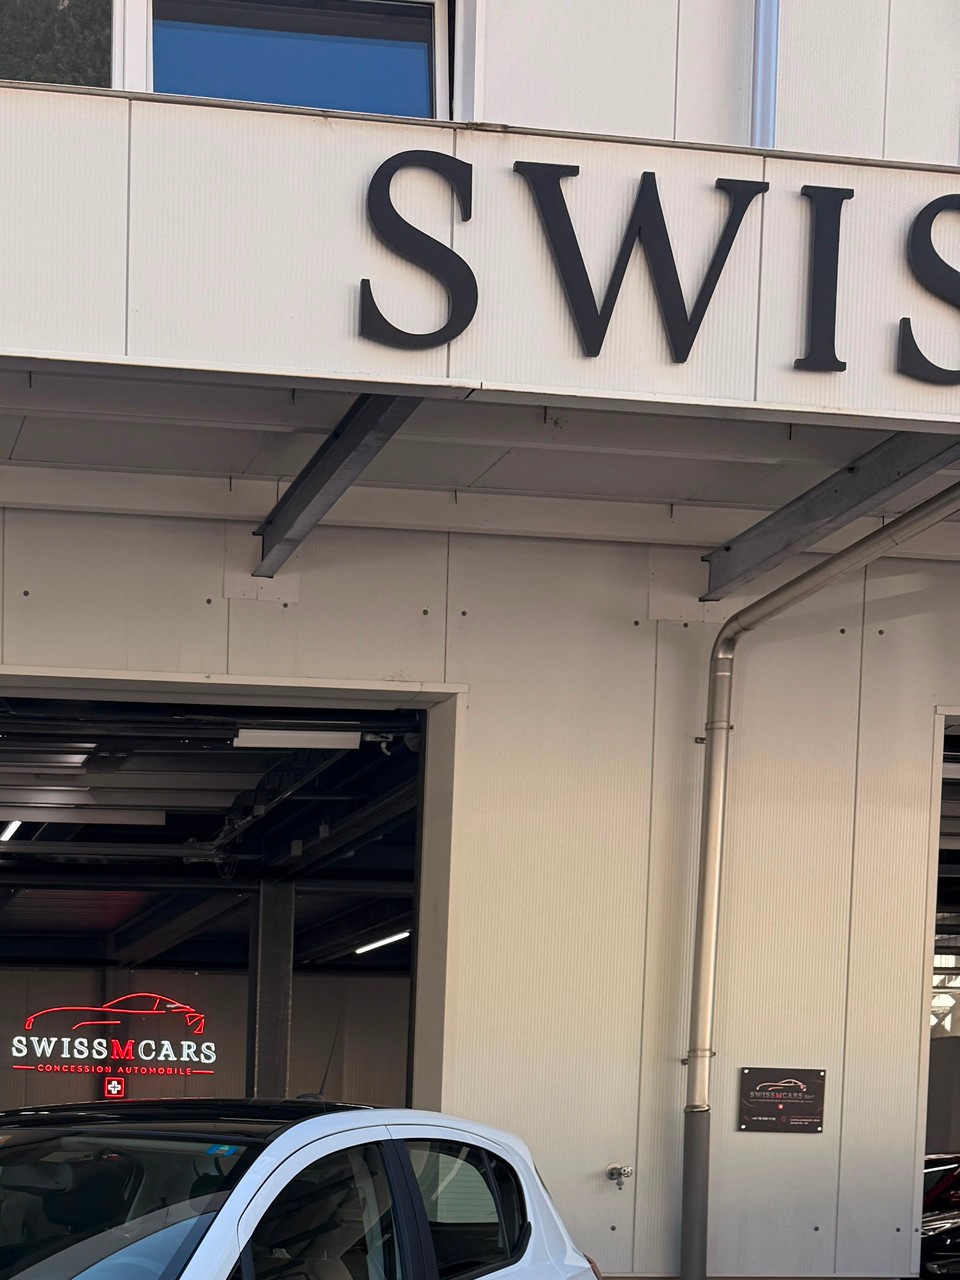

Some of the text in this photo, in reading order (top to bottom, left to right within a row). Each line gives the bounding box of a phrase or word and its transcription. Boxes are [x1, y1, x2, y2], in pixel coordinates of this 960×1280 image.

[12, 1036, 216, 1063] SWISSMCARS
[37, 1064, 192, 1075] CONCESSION AUTOMOBILE
